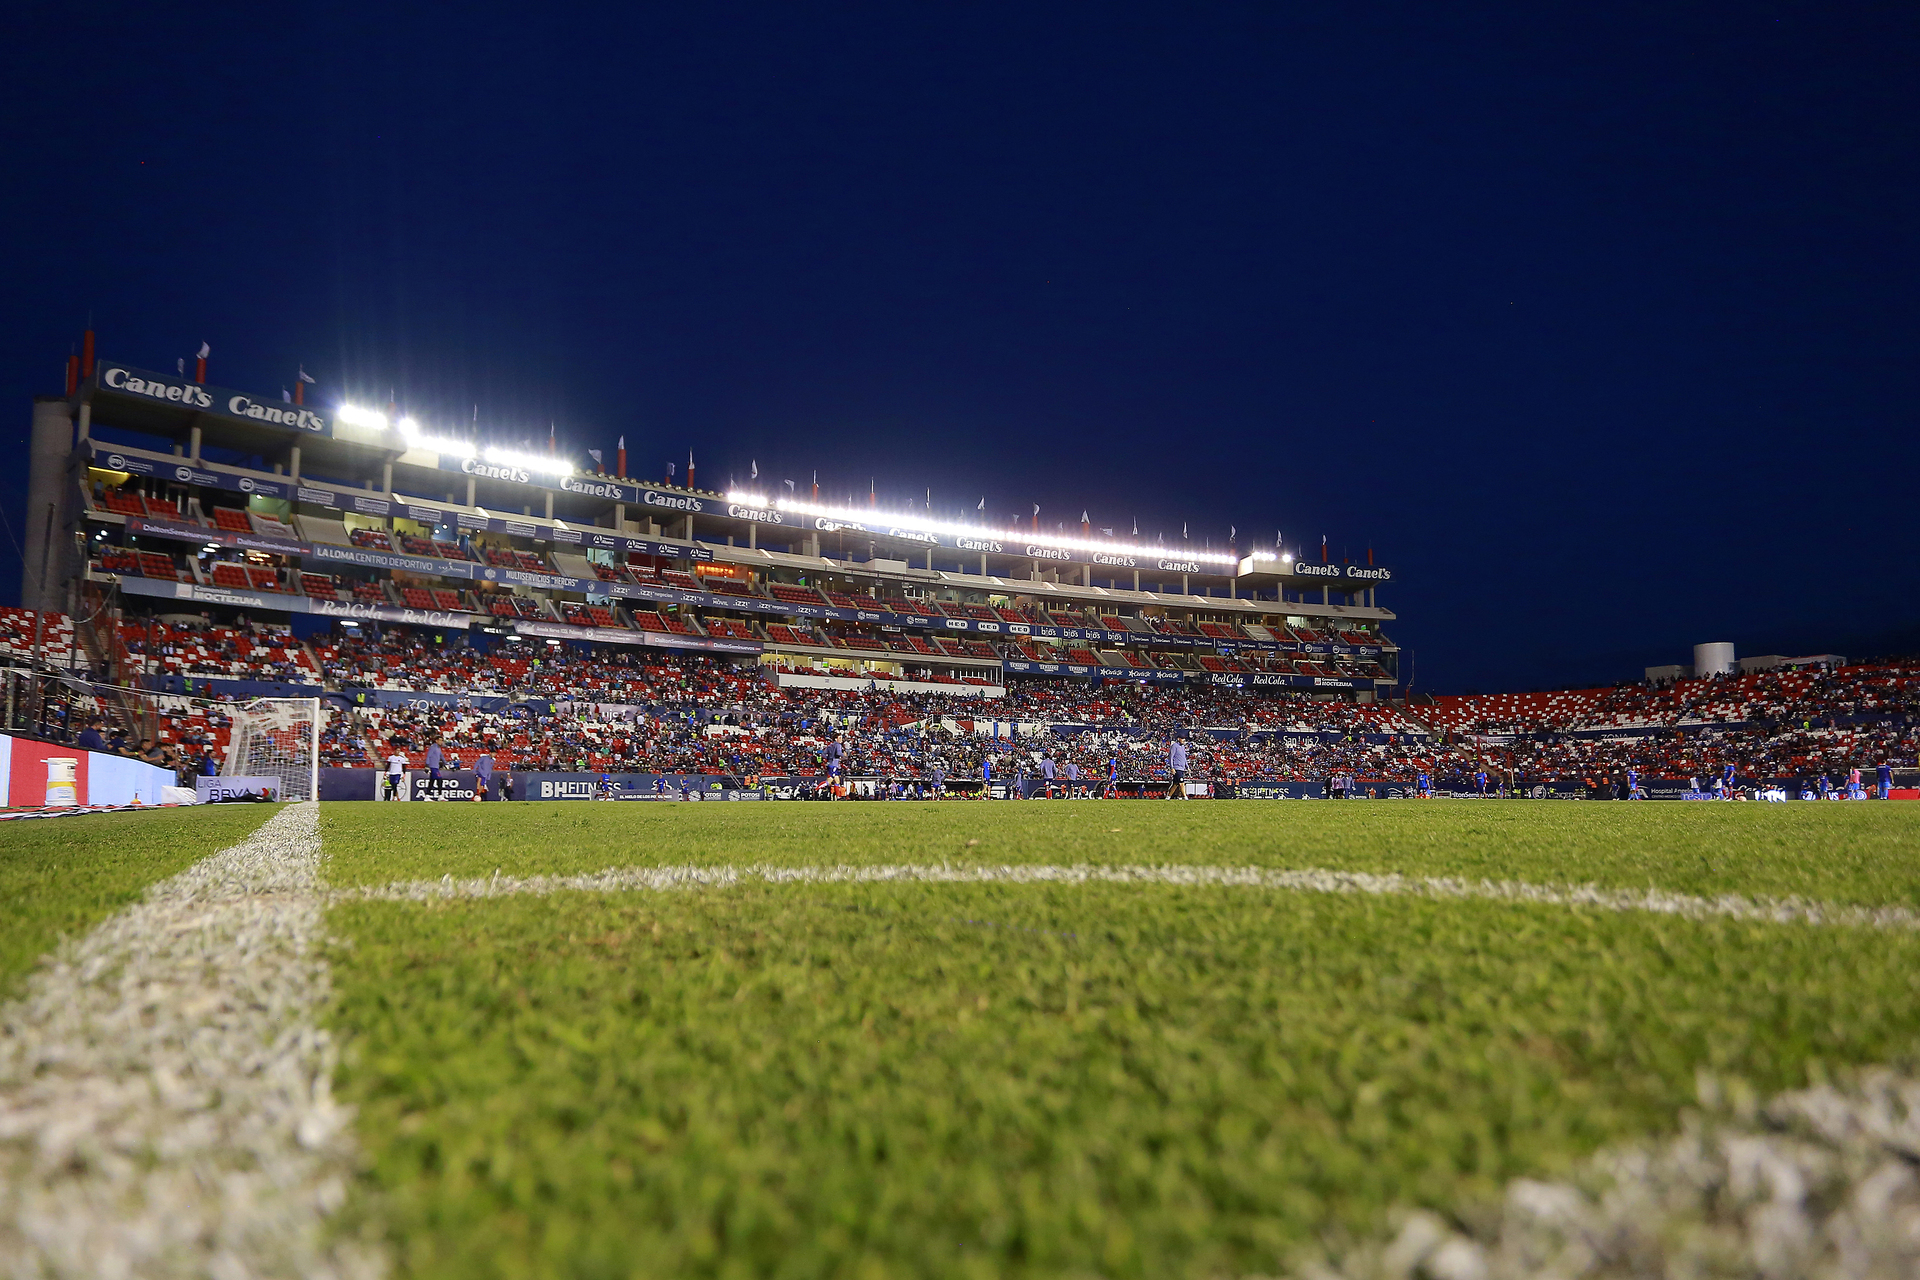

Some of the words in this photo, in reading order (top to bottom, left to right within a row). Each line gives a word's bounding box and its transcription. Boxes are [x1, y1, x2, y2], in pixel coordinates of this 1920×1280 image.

[105, 368, 212, 408] Canel's
[229, 396, 324, 431] Canel's
[461, 459, 529, 483] Canel's
[560, 477, 622, 500] Canel's
[644, 491, 702, 512] Canel's
[728, 505, 783, 524] Canel's
[317, 548, 328, 557] LA
[330, 550, 354, 562] LOMA
[356, 553, 386, 564] CENTRO
[389, 558, 433, 570] DEPORTIVO
[956, 537, 1003, 552] Canel's
[1026, 545, 1071, 560] Canel's
[1092, 552, 1136, 566] Canel's
[1158, 559, 1200, 572] Canel's
[1296, 562, 1340, 576] Canel's
[1347, 566, 1391, 580] Canel's
[506, 571, 550, 584] MULTISERVICIOS
[1283, 736, 1297, 745] San
[1315, 736, 1320, 746] 2
[198, 780, 221, 788] LIGA
